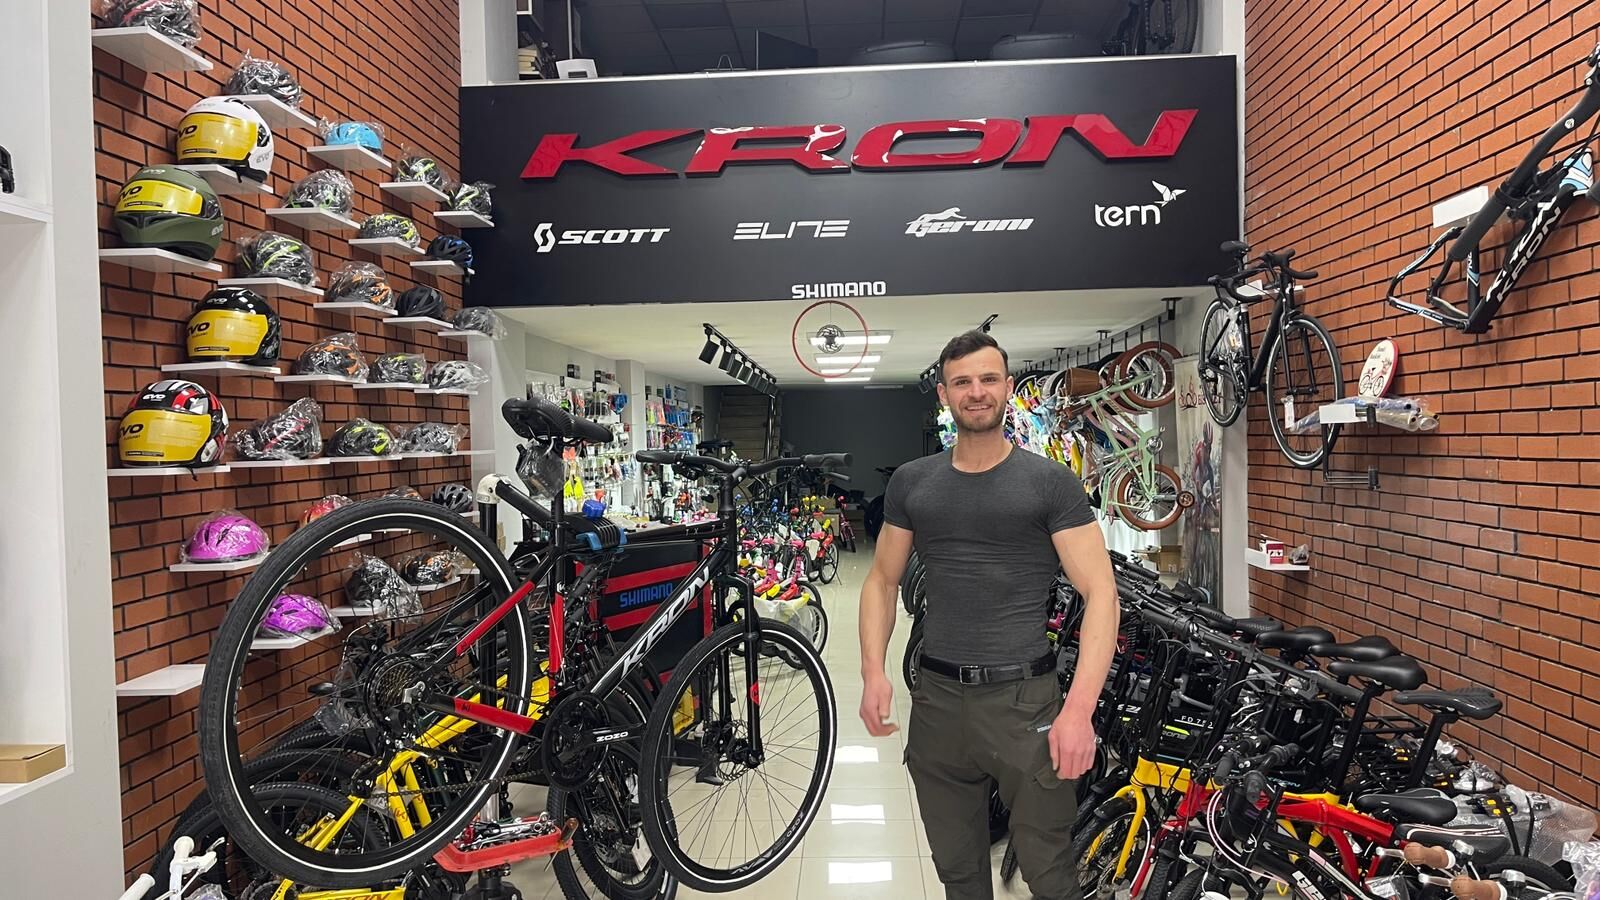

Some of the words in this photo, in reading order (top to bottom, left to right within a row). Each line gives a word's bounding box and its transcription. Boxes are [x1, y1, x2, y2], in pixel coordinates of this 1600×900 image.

[520, 108, 1199, 179] KRON
[1094, 203, 1161, 229] tern
[558, 228, 671, 245] SCOTT
[733, 219, 851, 241] ELITE
[1497, 206, 1561, 303] KRON
[791, 281, 887, 299] SHIMANO
[619, 582, 673, 608] SHIMANO
[621, 565, 710, 679] KRON
[596, 731, 629, 743] ZOZO
